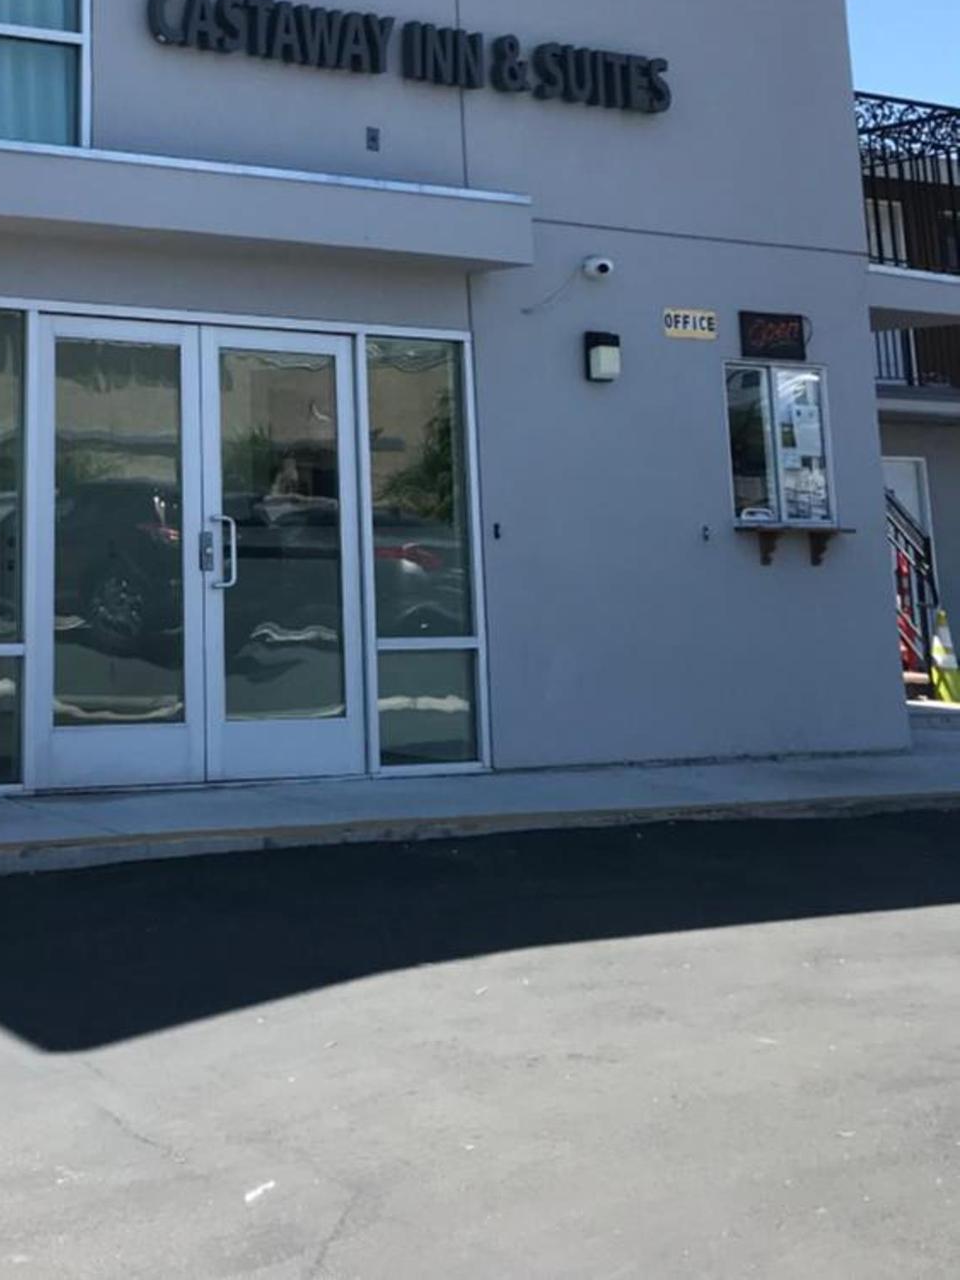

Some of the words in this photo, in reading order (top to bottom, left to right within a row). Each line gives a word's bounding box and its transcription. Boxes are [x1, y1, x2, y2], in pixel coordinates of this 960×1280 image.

[399, 20, 484, 89] INN
[492, 34, 532, 92] &
[533, 42, 672, 113] SUITES
[664, 314, 715, 332] OFFICE
